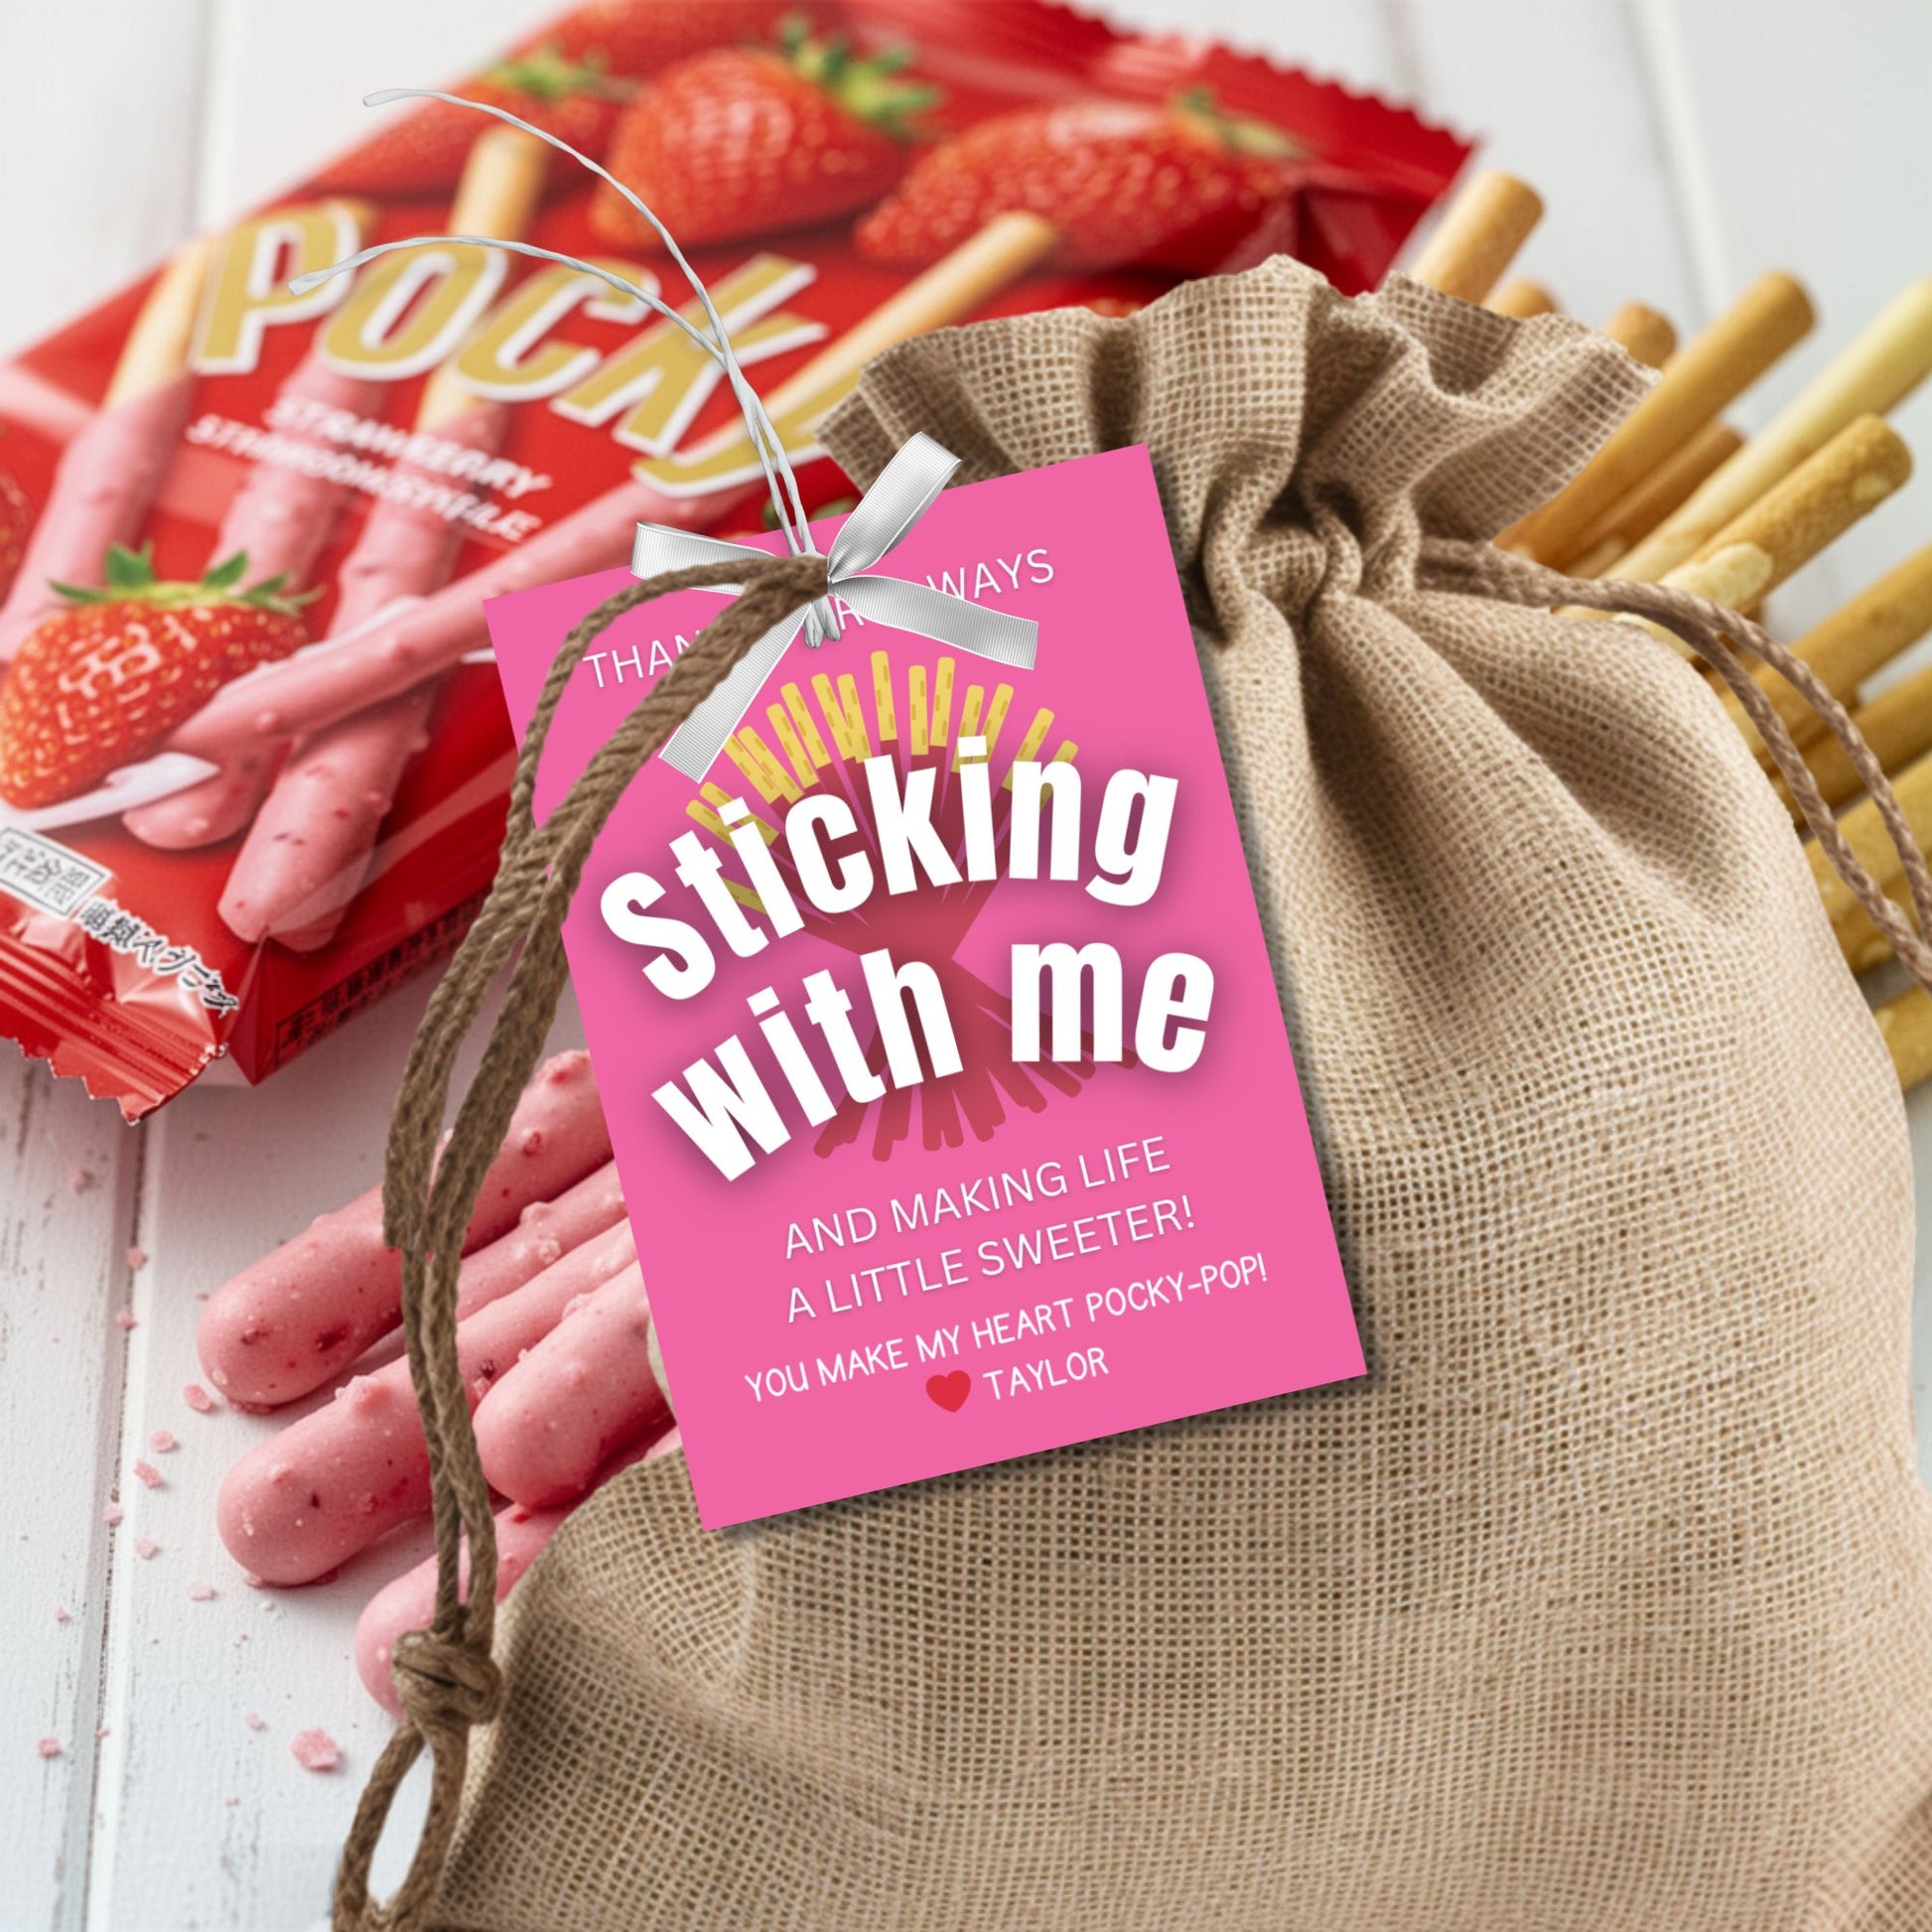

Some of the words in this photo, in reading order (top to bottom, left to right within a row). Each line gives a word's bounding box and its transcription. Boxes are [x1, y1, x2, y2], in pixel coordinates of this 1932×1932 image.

[600, 735, 1179, 1001] Sticking
[650, 947, 964, 1181] with
[1011, 942, 1215, 1073] me
[785, 1206, 878, 1259] AND
[890, 1162, 1067, 1233] MAKING
[1078, 1136, 1171, 1188] LIFE
[788, 1287, 816, 1323] A
[825, 1248, 969, 1313] LITTLE
[977, 1194, 1195, 1277] SWEETER!
[745, 1362, 809, 1402] YOU
[816, 1337, 908, 1386] MAKE
[915, 1324, 960, 1362] MY
[971, 1298, 1074, 1348] HEART
[1085, 1252, 1269, 1321] POCKY-POP!
[982, 1347, 1109, 1400] TAYLOR
